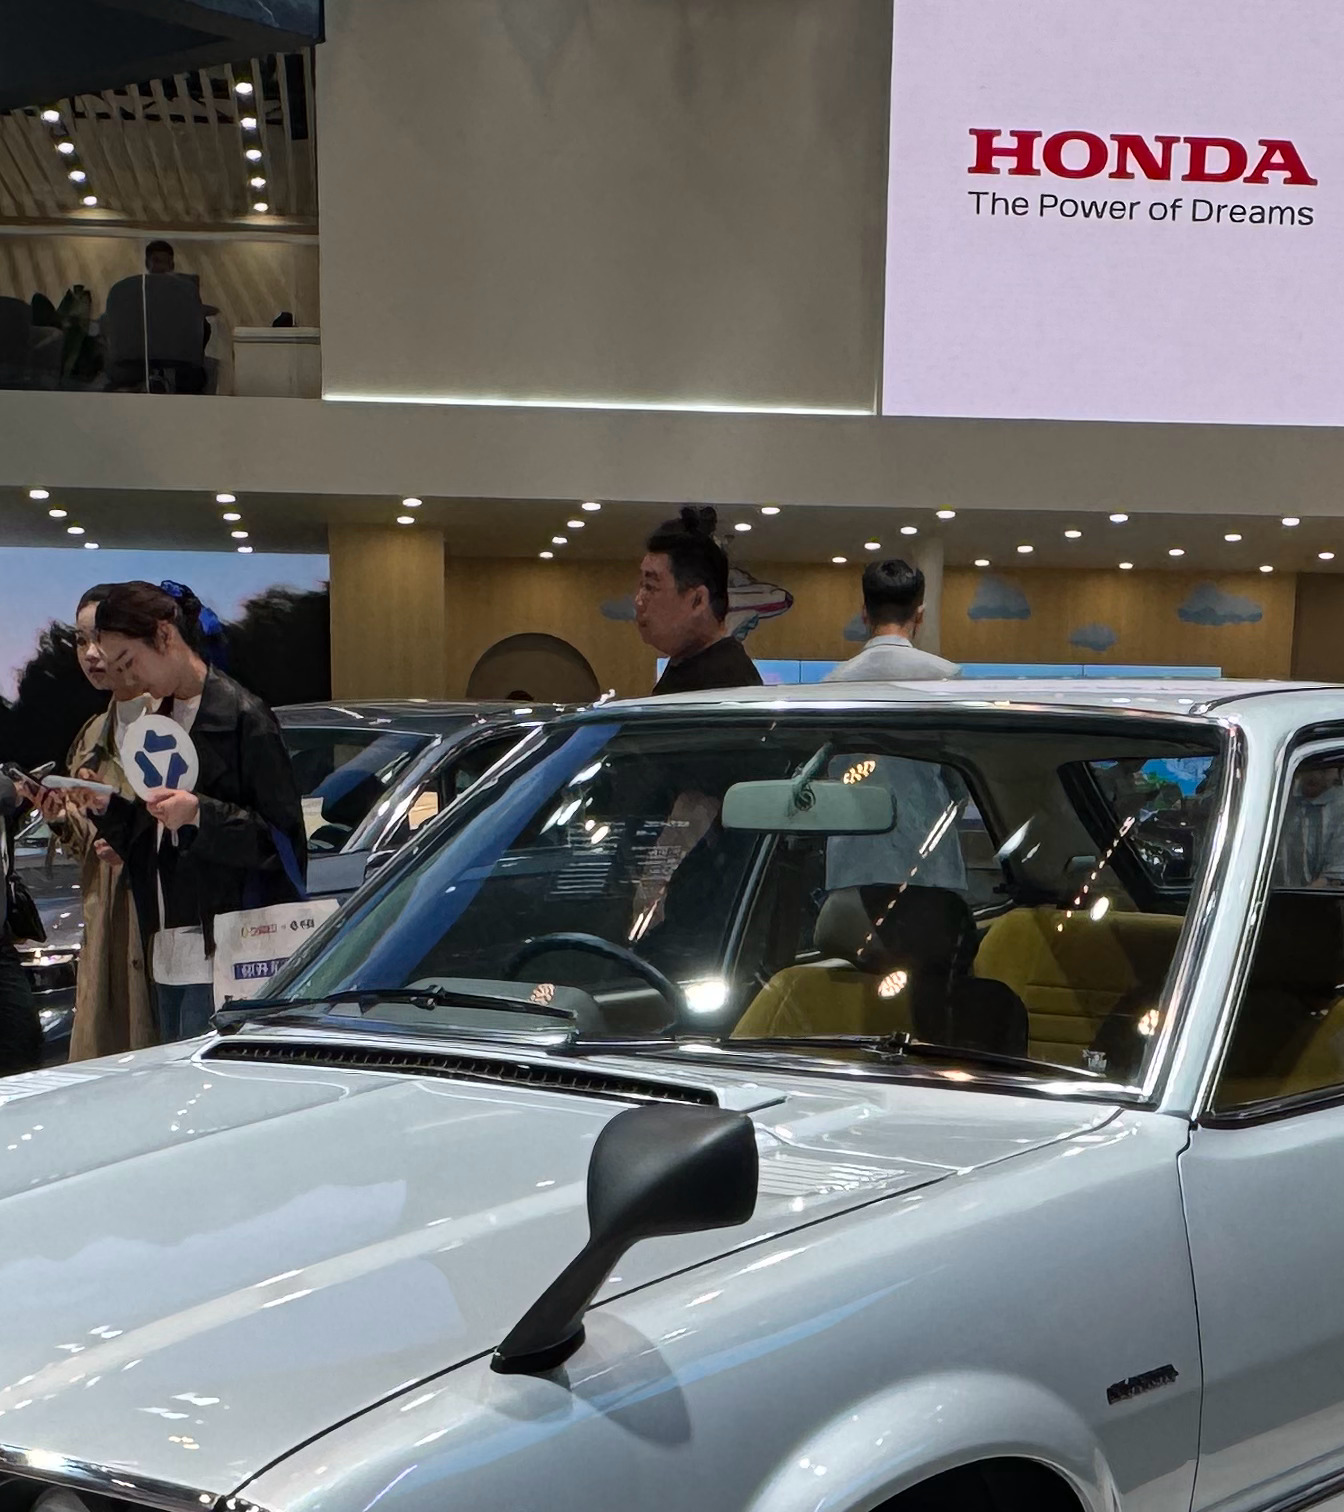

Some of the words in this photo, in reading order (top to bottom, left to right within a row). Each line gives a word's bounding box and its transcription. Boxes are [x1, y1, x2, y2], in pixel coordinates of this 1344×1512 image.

[968, 128, 1318, 186] HONDA
[968, 191, 1029, 216] The
[1039, 194, 1140, 220] Power
[1148, 198, 1183, 222] of
[1192, 199, 1314, 226] Dreams
